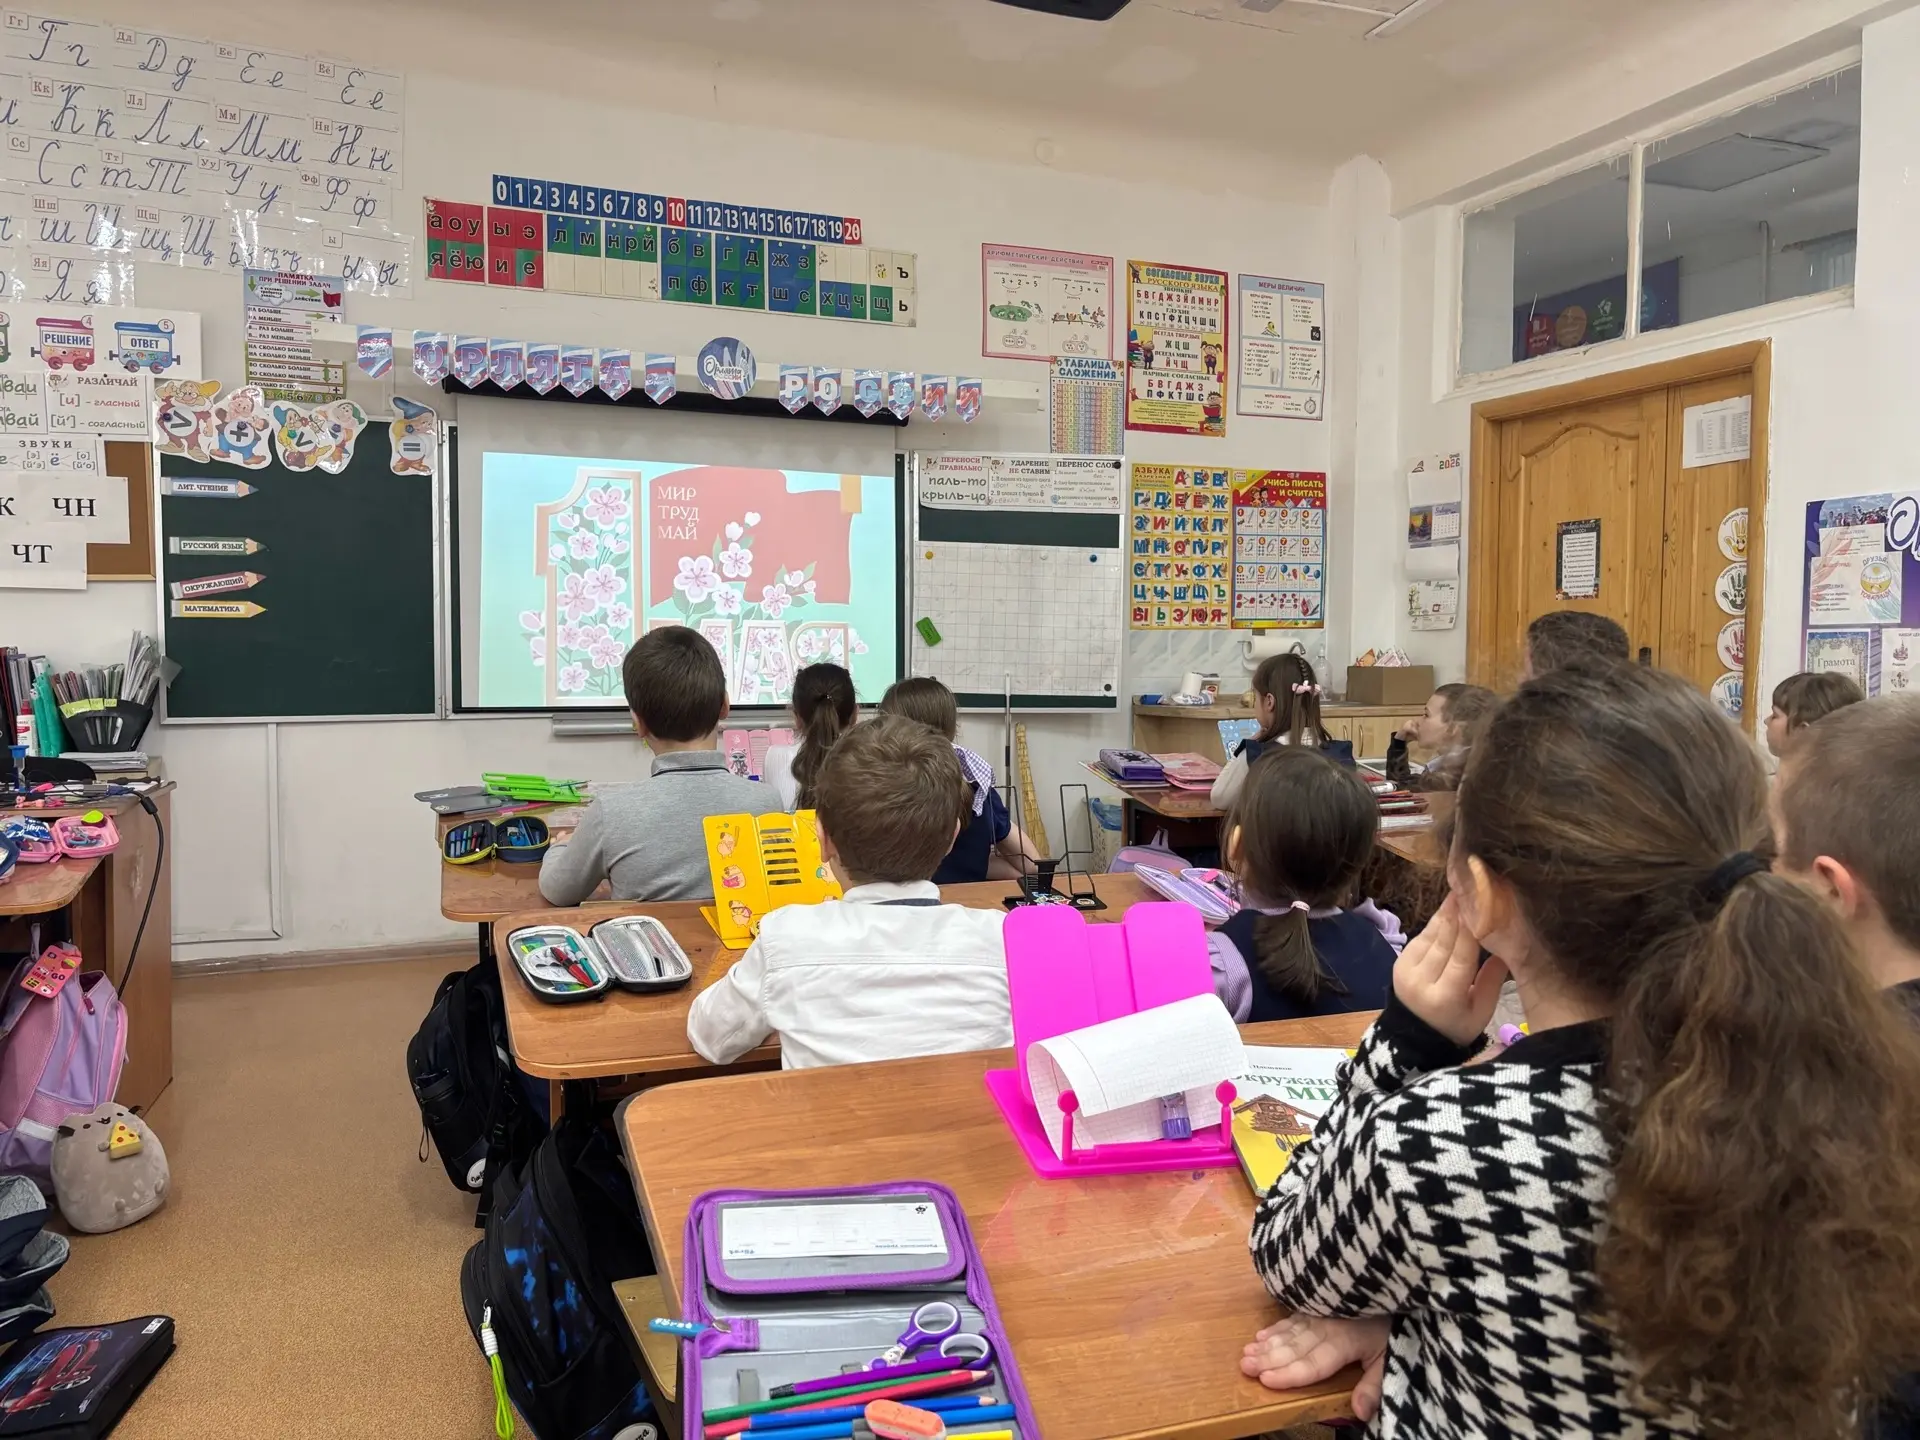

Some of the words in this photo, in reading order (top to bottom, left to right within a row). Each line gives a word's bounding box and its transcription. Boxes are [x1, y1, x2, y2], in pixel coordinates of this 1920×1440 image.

[497, 181, 507, 201] 0
[515, 183, 523, 203] 1
[533, 185, 543, 206] 2
[551, 187, 561, 208] 3
[568, 189, 579, 210] 4
[586, 192, 595, 212] 5
[603, 194, 614, 214] 6
[621, 196, 630, 216] 7
[637, 198, 647, 218] 8
[653, 200, 664, 220] 9
[669, 202, 684, 222] 10
[688, 205, 702, 225] 11
[706, 207, 722, 227] 12
[725, 209, 739, 229] 13
[742, 211, 758, 231] 14
[760, 213, 774, 232] 15
[777, 215, 792, 234] 16
[795, 217, 809, 236] 17
[812, 219, 826, 237] 18
[829, 221, 843, 239] 19
[845, 223, 860, 241] 20
[278, 272, 314, 281] ПАМЯТКА
[1147, 278, 1190, 288] РУССКОГО
[1191, 283, 1219, 292] ЯЗЫКА
[44, 333, 92, 346] РЕШЕНИЕ
[131, 338, 159, 349] ОТВЕТ
[1064, 359, 1111, 370] ТАБЛИЦА
[1059, 368, 1117, 380] СЛОЖЕНИЯ
[77, 376, 138, 387] РАЗЛИЧАЙ
[88, 421, 146, 429] согласный
[940, 456, 981, 464] ПЕРЕНОСИ
[1439, 458, 1460, 470] 2026
[939, 464, 982, 472] ПРАВИЛЬНО
[1134, 466, 1170, 474] АЗБУКА
[929, 476, 987, 487] паль-то
[657, 485, 697, 501] МИР
[922, 491, 987, 504] крыль-цо
[1287, 489, 1324, 497] СЧИТАТЬ
[52, 497, 97, 518] ЧН
[658, 505, 699, 524] ТРУД
[657, 521, 698, 540] МАЙ
[182, 541, 220, 550] РУССКИЙ
[222, 541, 244, 551] ЯЗЫК
[11, 544, 53, 564] ЧТ
[184, 576, 244, 593] ОКРУЖАЮЩИЙ
[184, 605, 241, 613] МАТЕМАТИКА
[1817, 657, 1856, 669] Грамота
